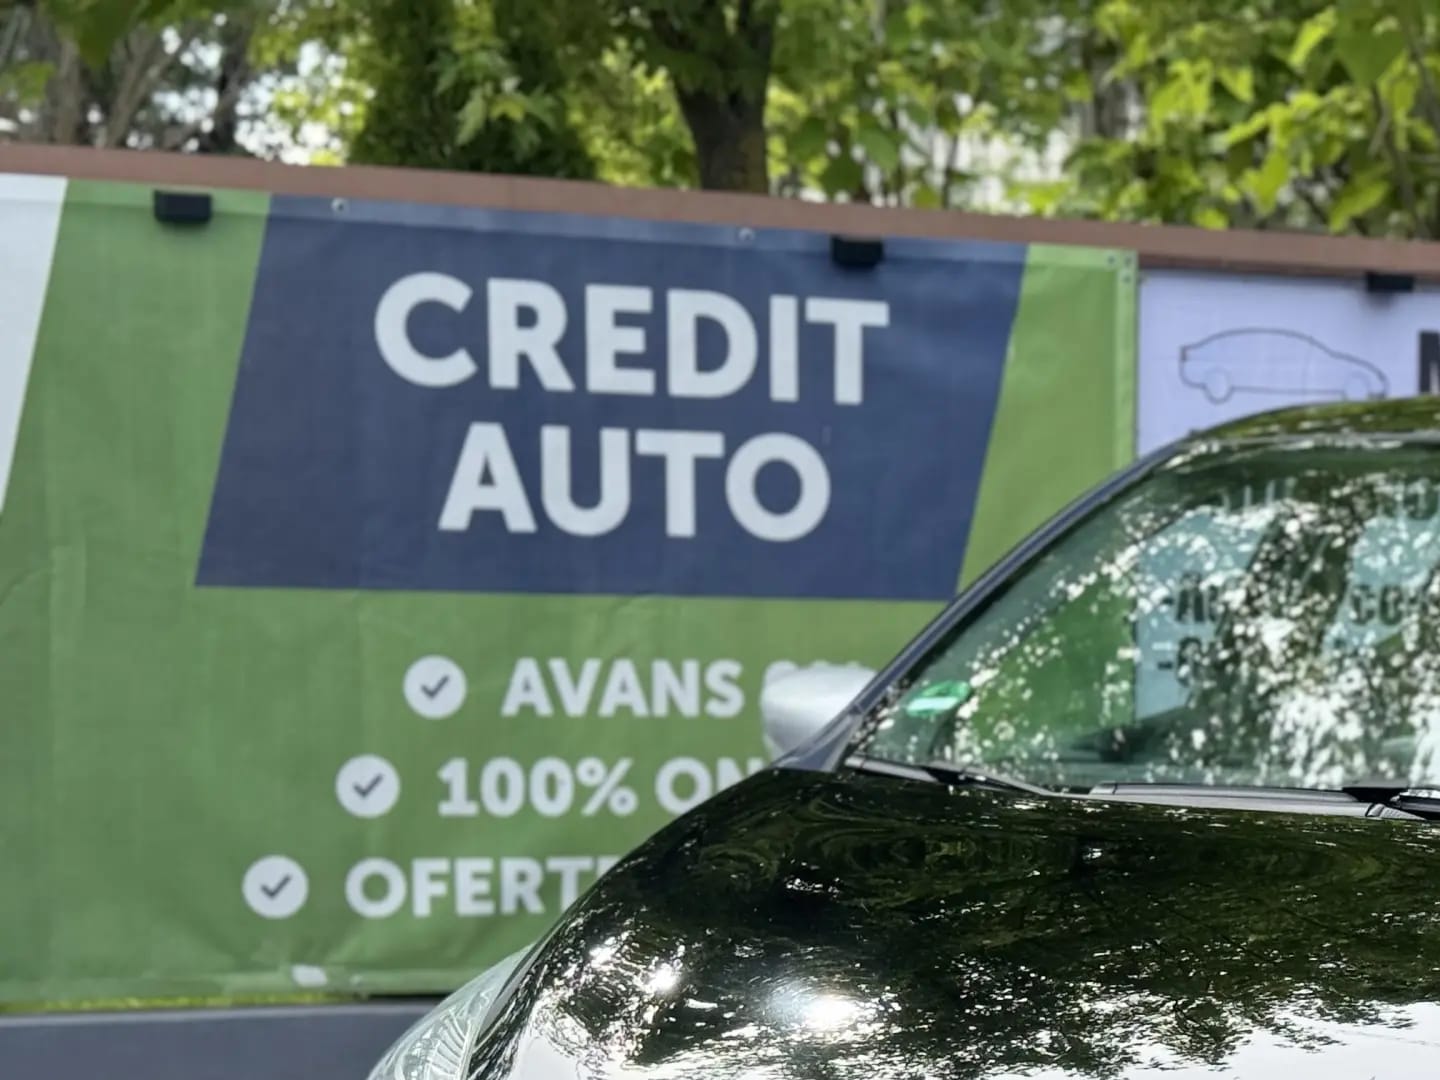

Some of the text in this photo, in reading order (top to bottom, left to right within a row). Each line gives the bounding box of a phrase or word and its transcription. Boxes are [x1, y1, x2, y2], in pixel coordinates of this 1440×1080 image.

[374, 271, 890, 406] CREDIT
[437, 421, 832, 542] AUTO
[500, 656, 745, 719] AVANS
[437, 756, 639, 818] 100%
